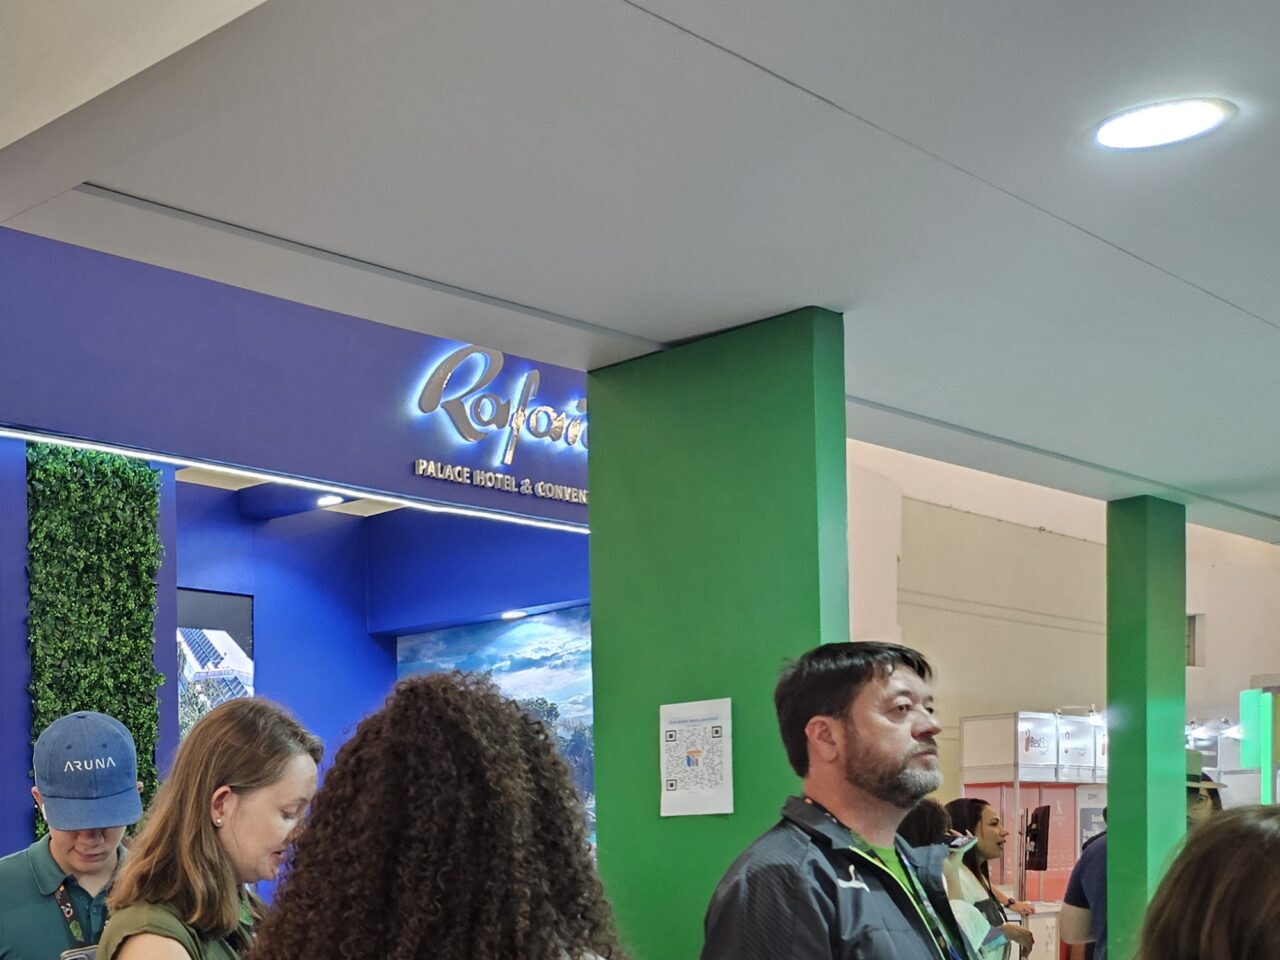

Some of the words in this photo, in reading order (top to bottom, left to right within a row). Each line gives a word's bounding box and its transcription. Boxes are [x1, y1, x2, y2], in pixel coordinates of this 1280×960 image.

[418, 344, 588, 465] Rafai
[415, 459, 470, 484] PALACE
[473, 470, 518, 492] HOTEL
[520, 479, 532, 495] &
[63, 757, 116, 772] ARUNA
